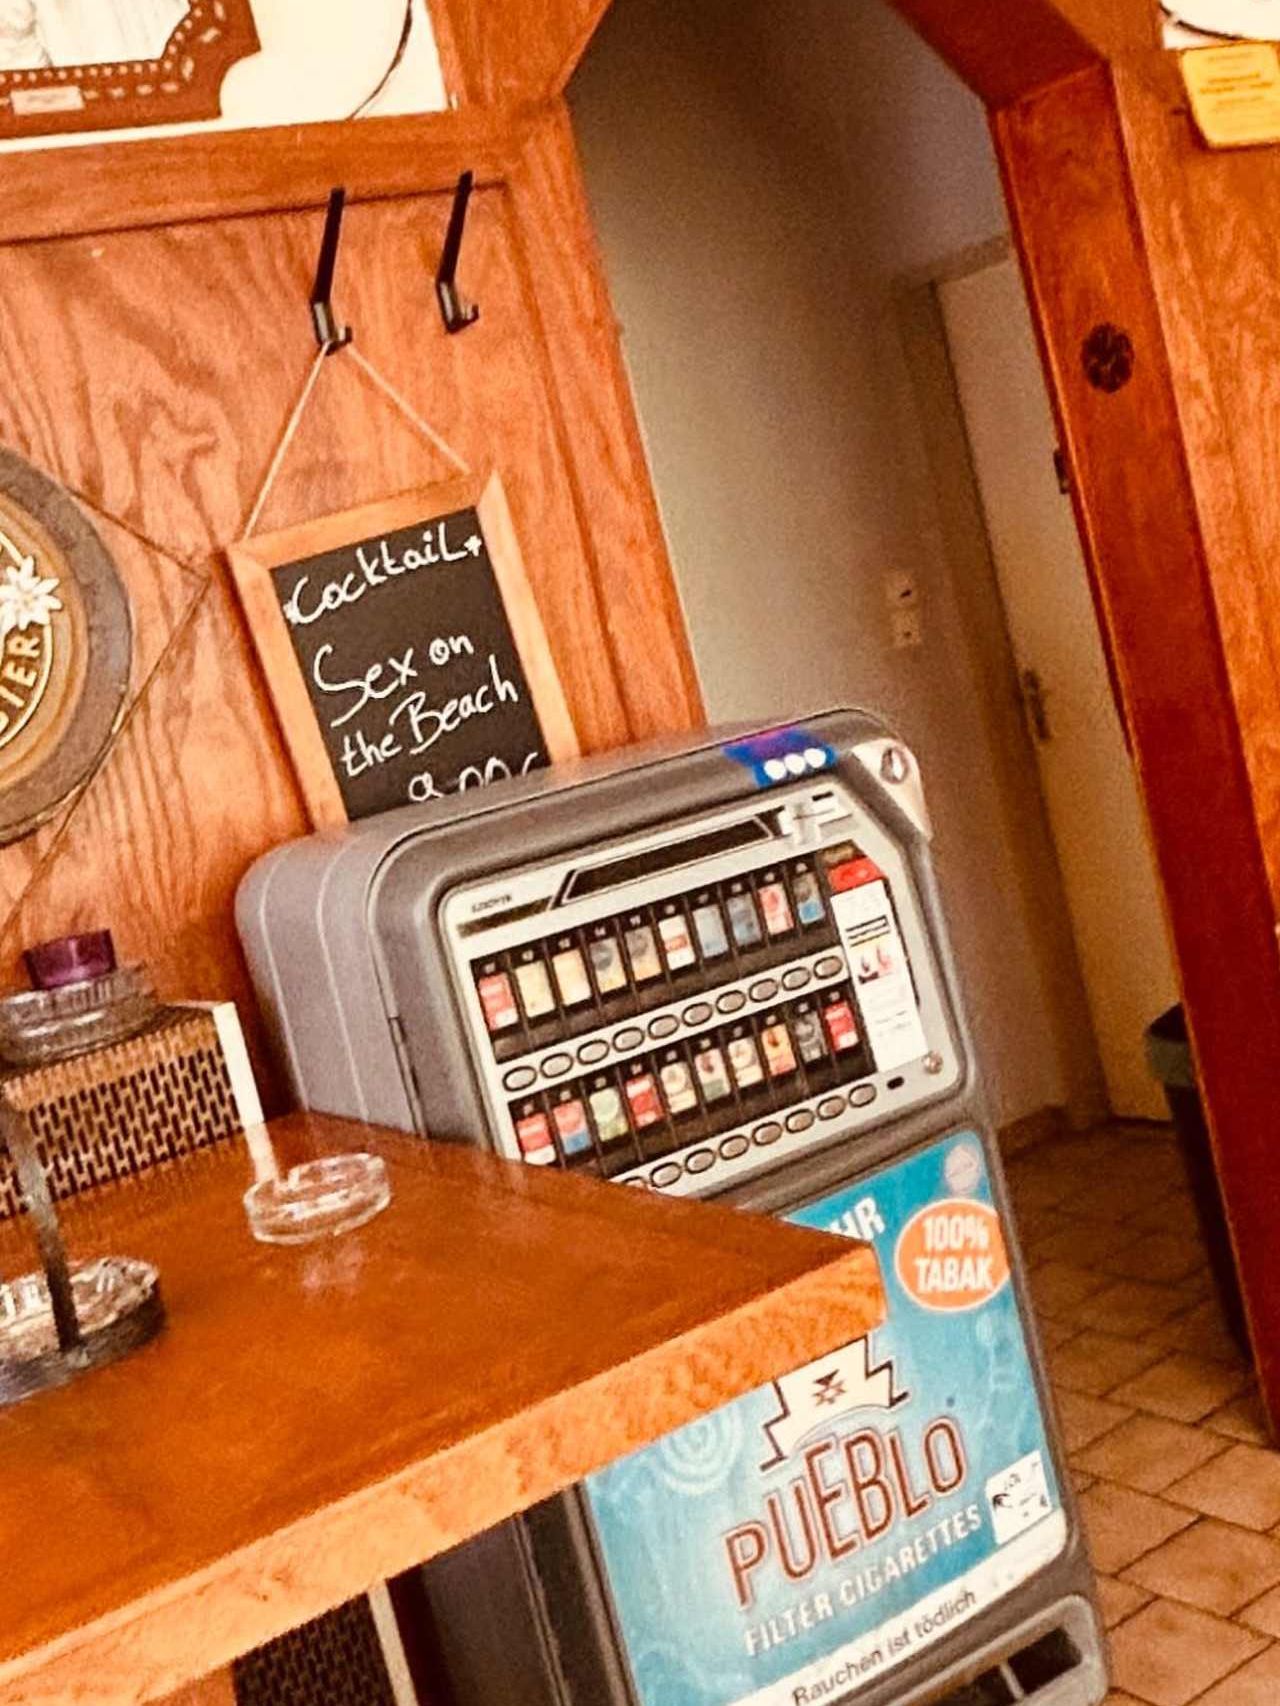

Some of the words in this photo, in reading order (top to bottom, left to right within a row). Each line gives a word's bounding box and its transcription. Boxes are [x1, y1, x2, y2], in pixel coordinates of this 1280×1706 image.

[313, 644, 418, 728] Sex
[429, 634, 474, 666] on
[342, 730, 402, 777] the
[389, 654, 519, 755] Beach
[913, 1255, 994, 1294] TABAK
[923, 1214, 991, 1252] 100%
[722, 1415, 969, 1610] PUEBLO
[743, 1595, 834, 1657] FILTER
[838, 1504, 983, 1607] CIGARETTES
[888, 1632, 911, 1658] ist
[916, 1590, 978, 1640] tödlich
